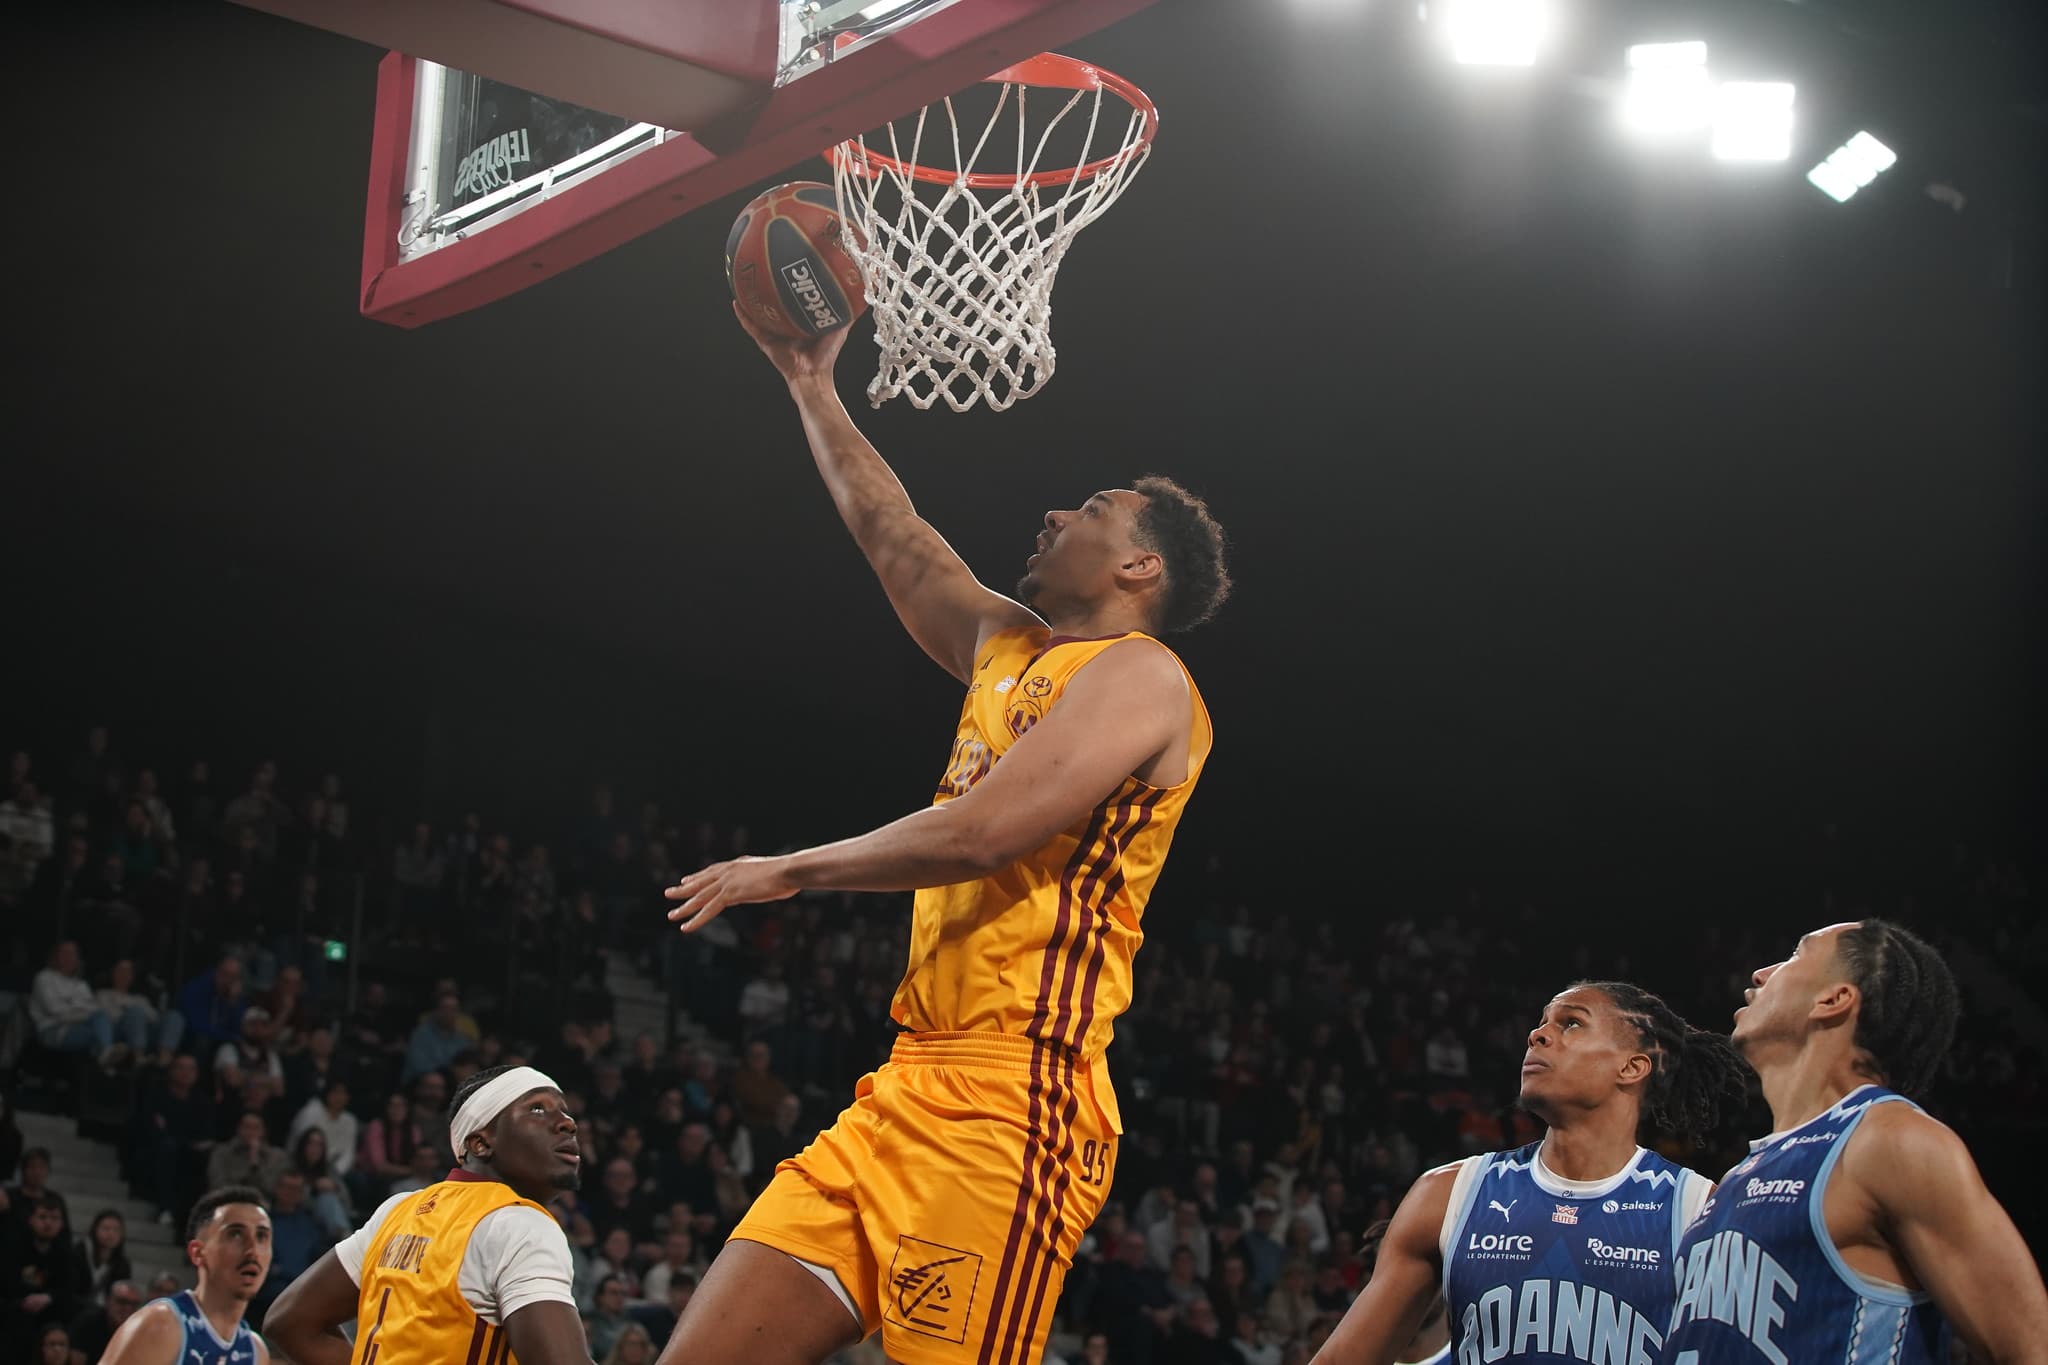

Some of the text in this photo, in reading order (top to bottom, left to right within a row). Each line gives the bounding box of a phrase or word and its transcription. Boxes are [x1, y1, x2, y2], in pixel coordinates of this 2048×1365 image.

[792, 265, 838, 329] Betclic
[1080, 1139, 1109, 1186] 95
[1746, 1177, 1804, 1197] Roanne
[1768, 1195, 1798, 1204] SPORT
[1469, 1233, 1533, 1251] Loire
[1587, 1237, 1660, 1263] Roanne
[1477, 1252, 1531, 1260] DÉPARTEMENT
[1630, 1263, 1659, 1271] SPORT
